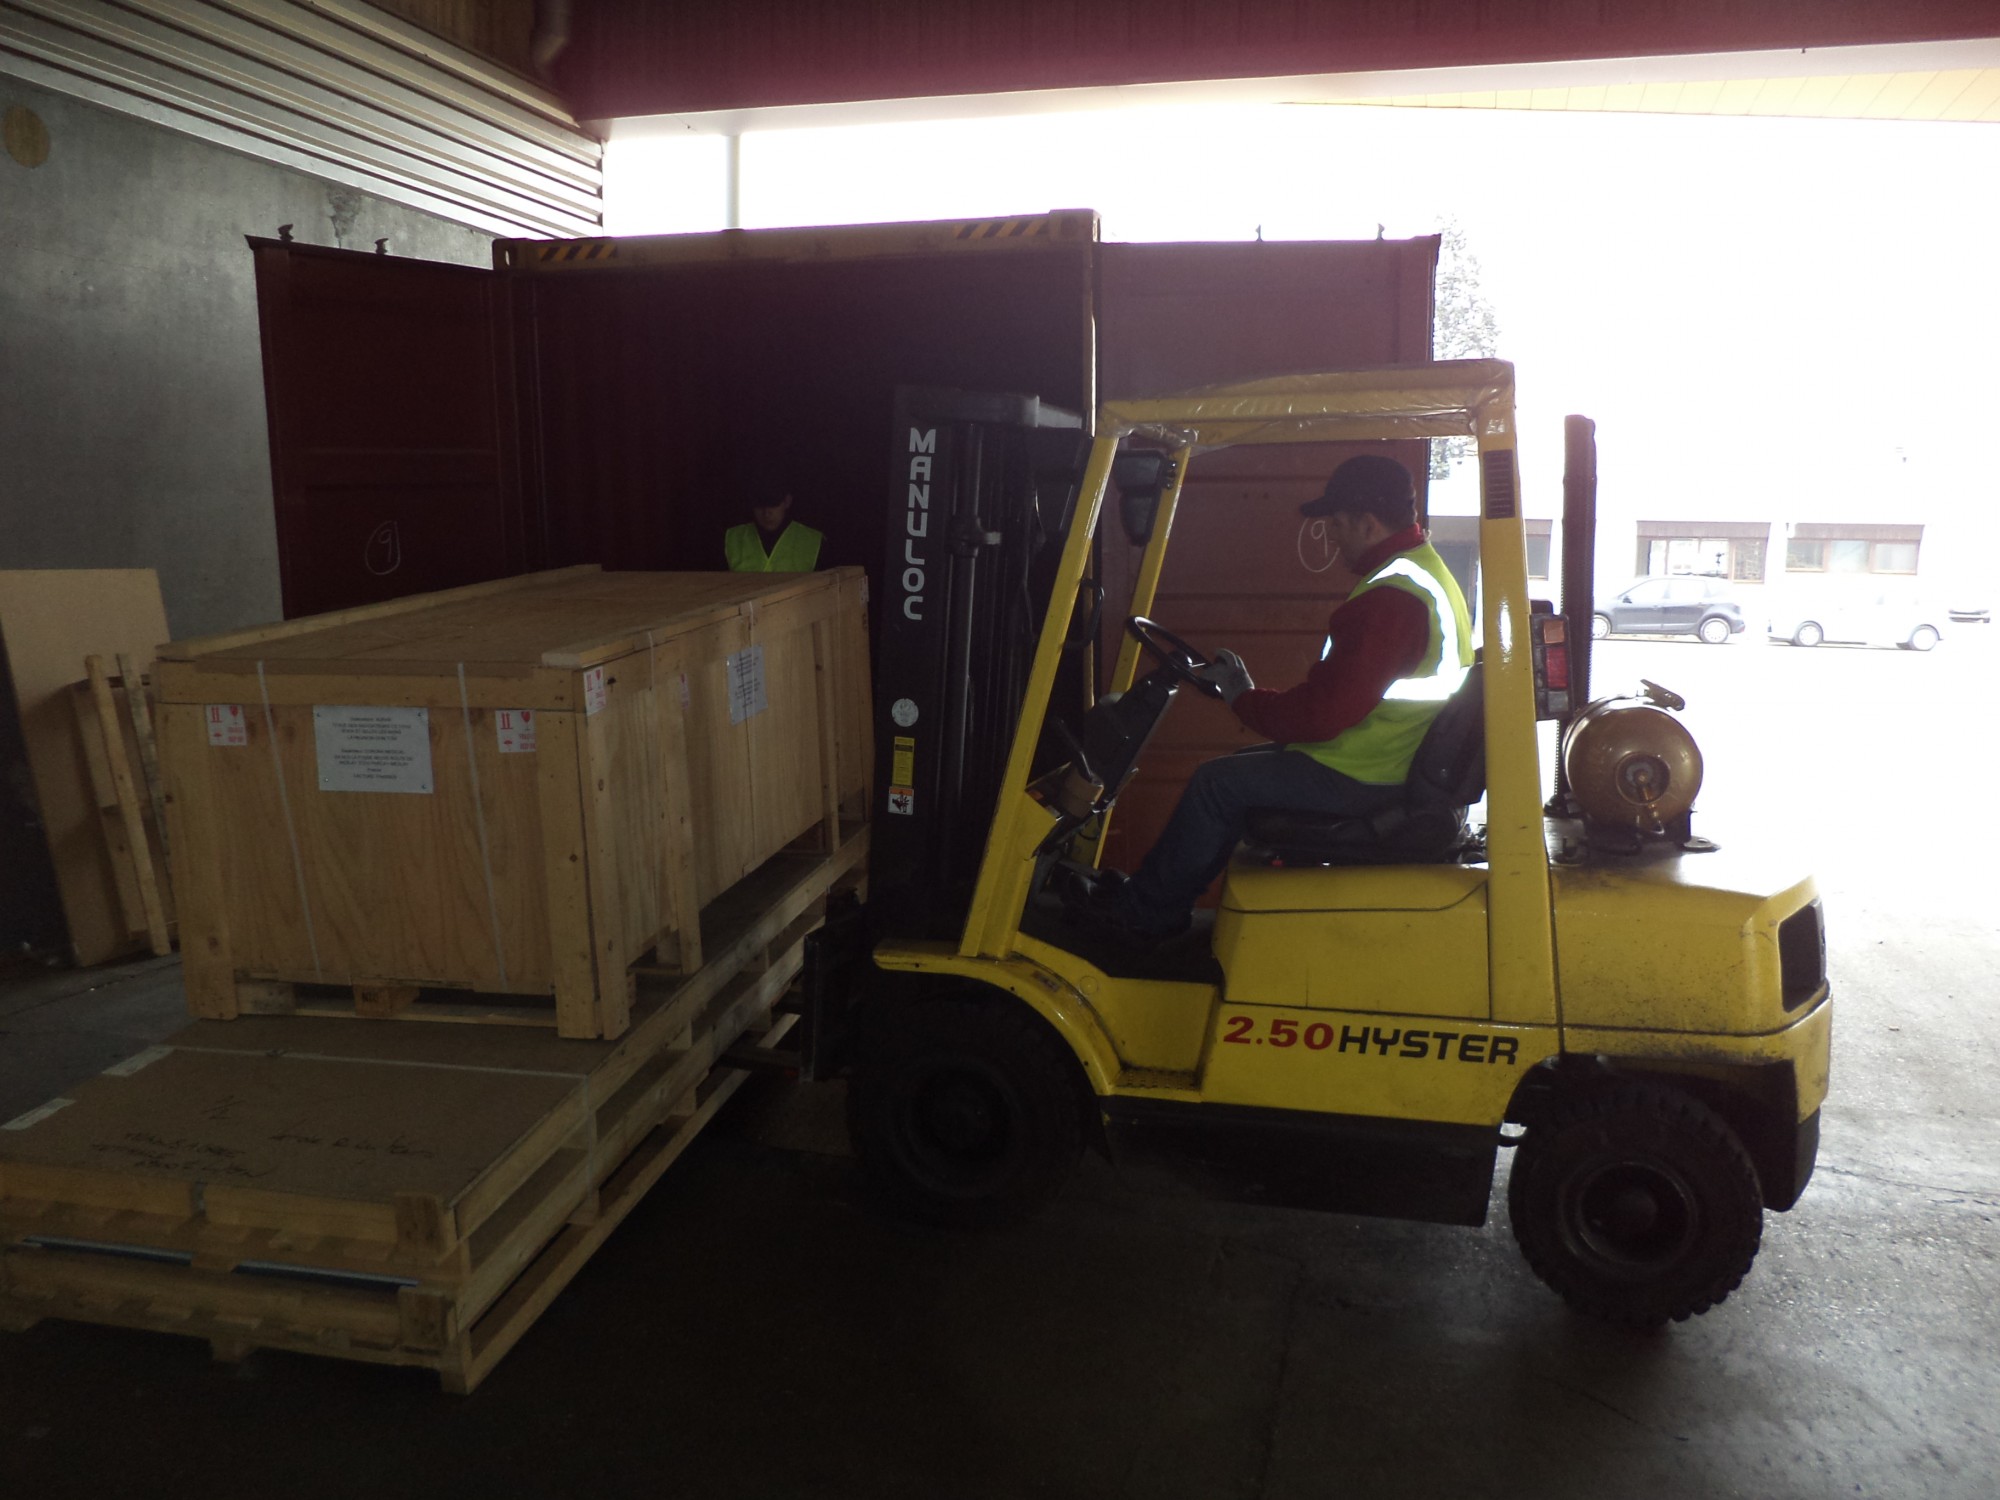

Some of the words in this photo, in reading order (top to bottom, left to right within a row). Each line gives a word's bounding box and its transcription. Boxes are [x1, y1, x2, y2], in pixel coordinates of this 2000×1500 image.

[903, 427, 936, 620] MANULOC
[1223, 1016, 1334, 1050] 2.50
[1338, 1025, 1519, 1065] HYSTER
